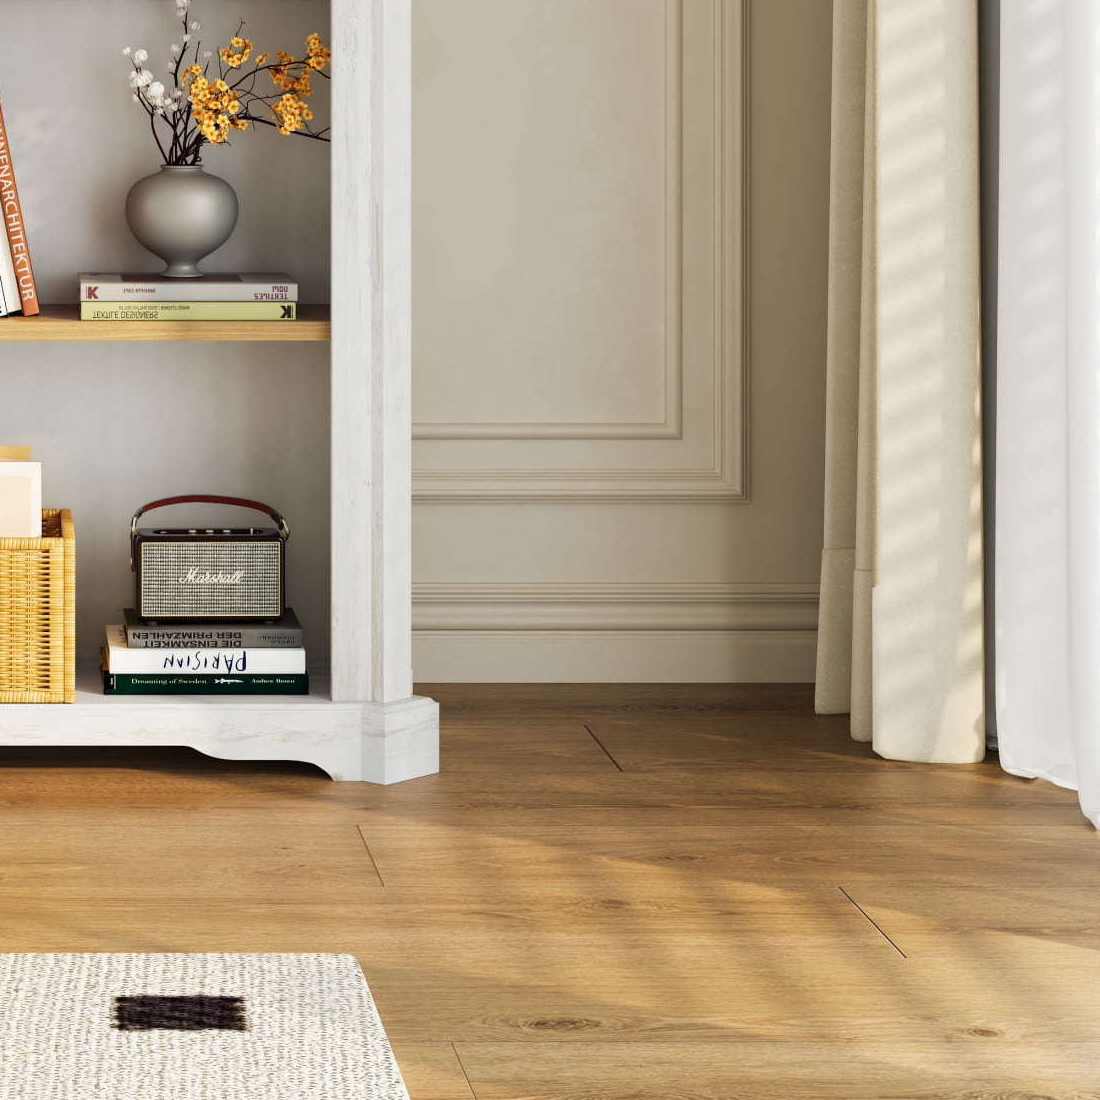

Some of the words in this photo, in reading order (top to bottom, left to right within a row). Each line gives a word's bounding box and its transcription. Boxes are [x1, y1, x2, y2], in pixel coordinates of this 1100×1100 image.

[179, 566, 245, 584] Marshall
[133, 632, 213, 640] PRIMZAHLEN
[143, 640, 217, 648] EINSAMKEIT
[222, 640, 242, 648] DIE
[163, 651, 247, 675] PARISIAN
